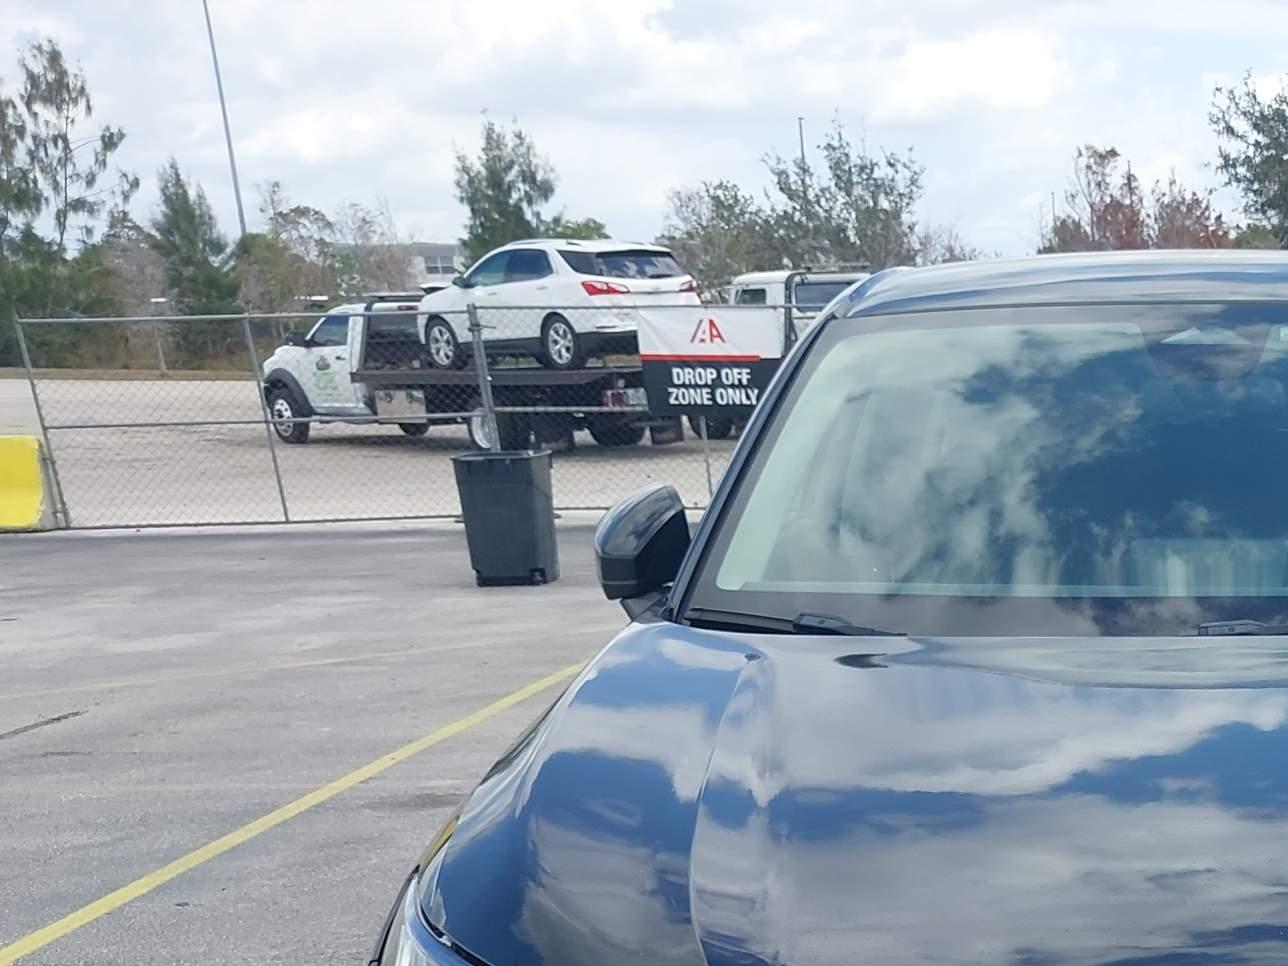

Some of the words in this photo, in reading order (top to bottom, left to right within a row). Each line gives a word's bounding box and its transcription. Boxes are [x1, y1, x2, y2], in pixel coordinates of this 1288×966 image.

[672, 368, 717, 385] DROP
[721, 368, 751, 385] OFF
[668, 388, 713, 405] ZONE
[716, 388, 759, 405] ONLY
